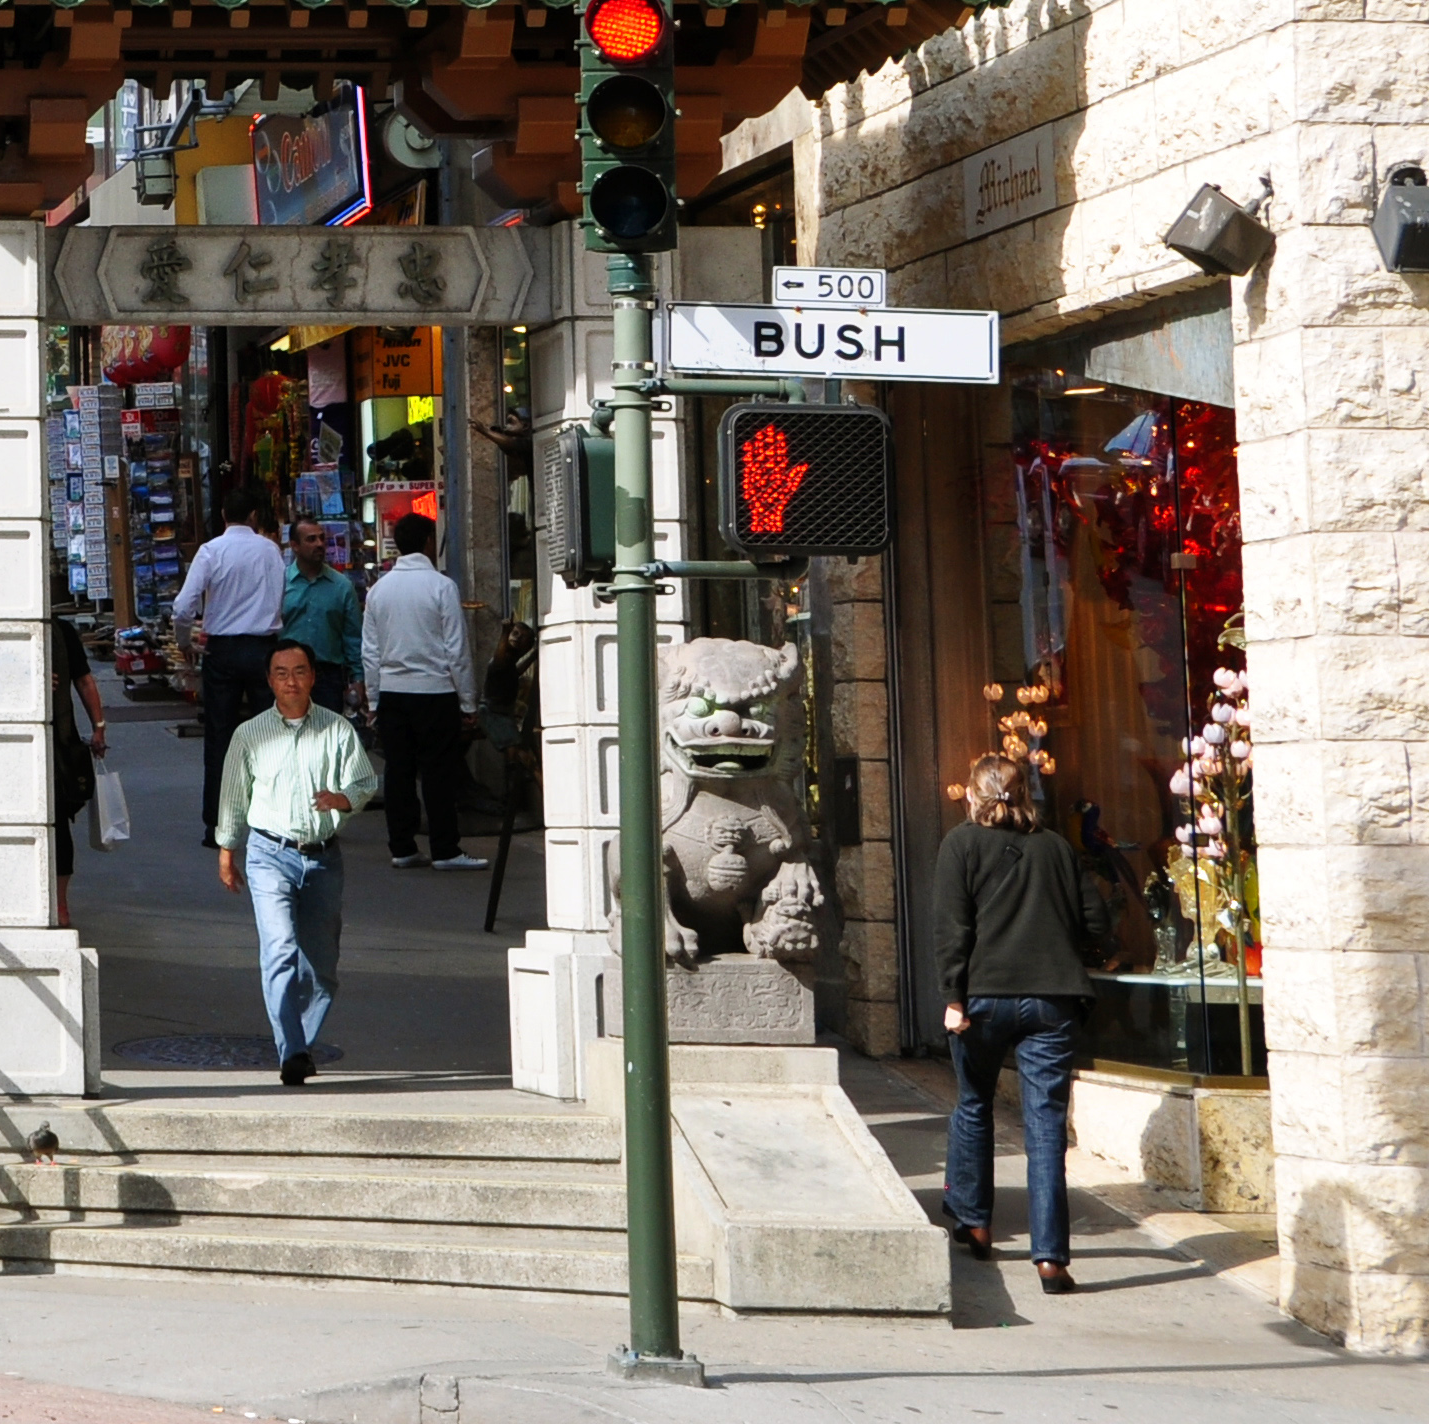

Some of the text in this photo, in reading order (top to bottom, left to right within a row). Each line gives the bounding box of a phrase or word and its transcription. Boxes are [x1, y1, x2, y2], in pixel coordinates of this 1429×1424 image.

[976, 142, 1042, 224] Michael
[142, 232, 445, 307] 忠孝仁愛
[818, 275, 874, 299] 500
[753, 320, 906, 362] BUSH
[382, 354, 411, 367] JVC
[382, 374, 401, 390] Fuji
[409, 481, 435, 490] SUPER
